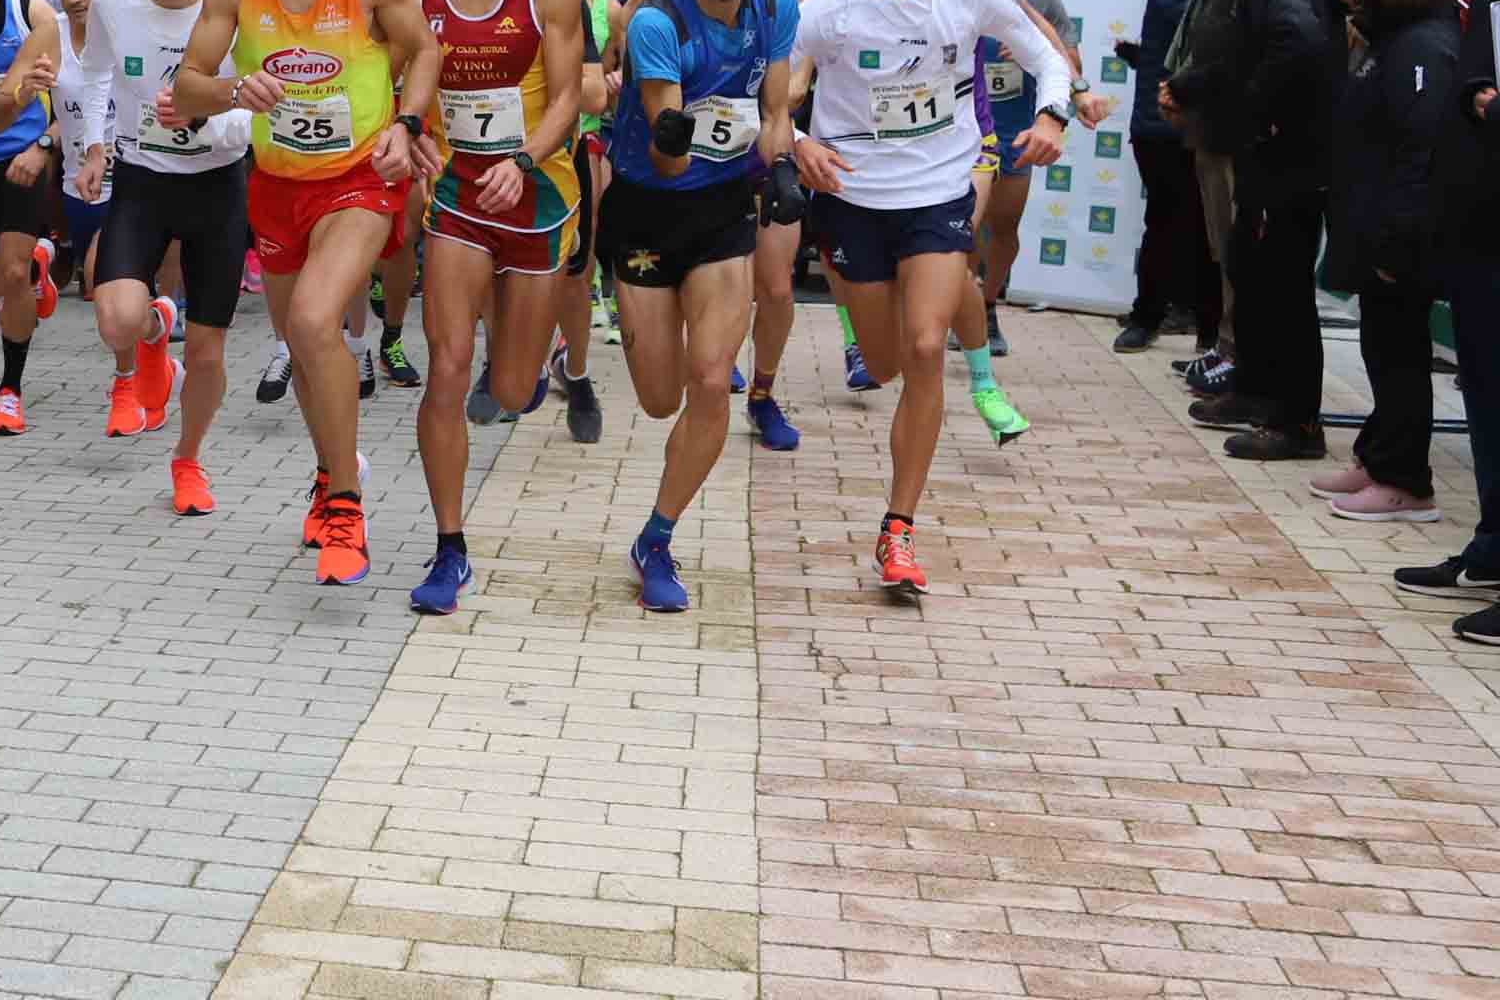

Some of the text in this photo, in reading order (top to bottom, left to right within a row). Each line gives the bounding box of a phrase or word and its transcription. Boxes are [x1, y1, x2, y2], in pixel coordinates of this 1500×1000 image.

[480, 45, 509, 53] RURAL
[269, 59, 336, 75] Serrano
[453, 61, 493, 71] VINO
[444, 72, 508, 81] DE TORO
[64, 100, 82, 113] LA
[903, 96, 937, 124] 11
[291, 118, 335, 140] 25
[474, 112, 494, 138] 7
[711, 119, 733, 145] 5
[171, 127, 190, 146] 3
